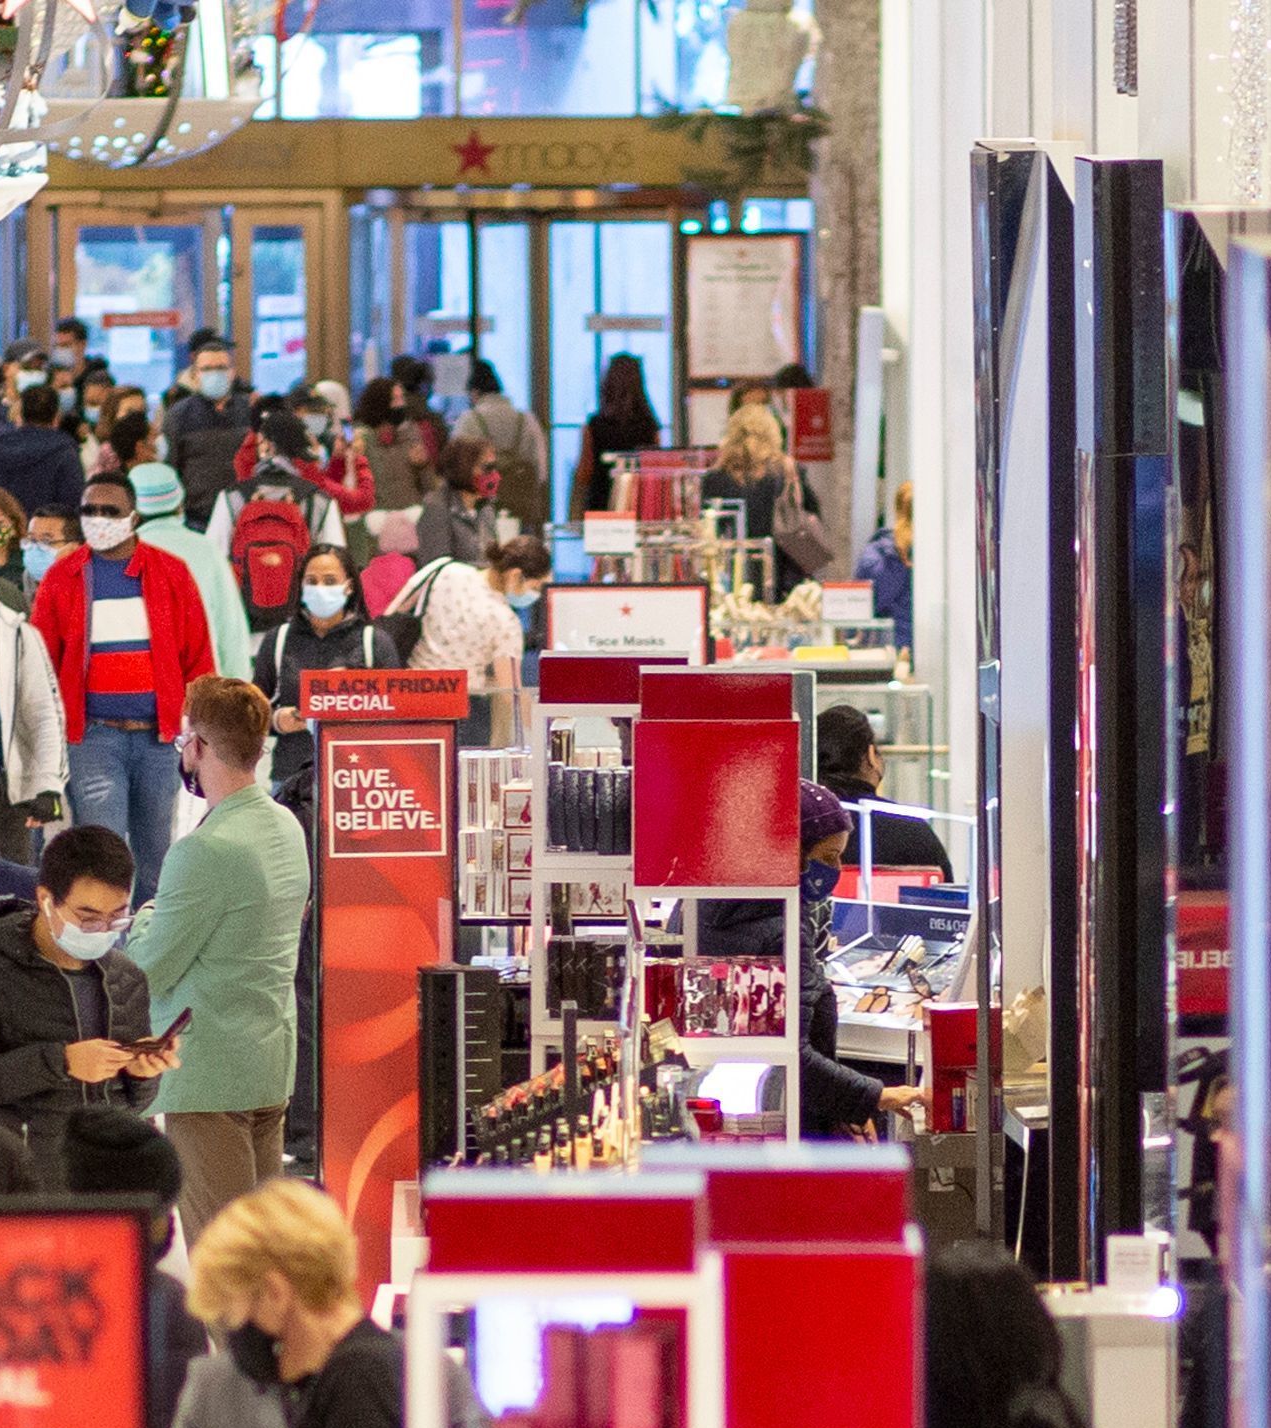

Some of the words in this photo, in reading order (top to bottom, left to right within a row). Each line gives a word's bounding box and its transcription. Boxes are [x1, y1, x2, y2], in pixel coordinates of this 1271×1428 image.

[588, 635, 618, 646] Face
[623, 635, 665, 646] Masks
[311, 679, 379, 694] BLACK
[387, 678, 460, 694] FRIDAY
[309, 695, 396, 711] SPECIAL
[334, 769, 397, 788] GIVE.
[351, 790, 421, 809] LOVE.
[335, 811, 442, 830] BELIEVE.
